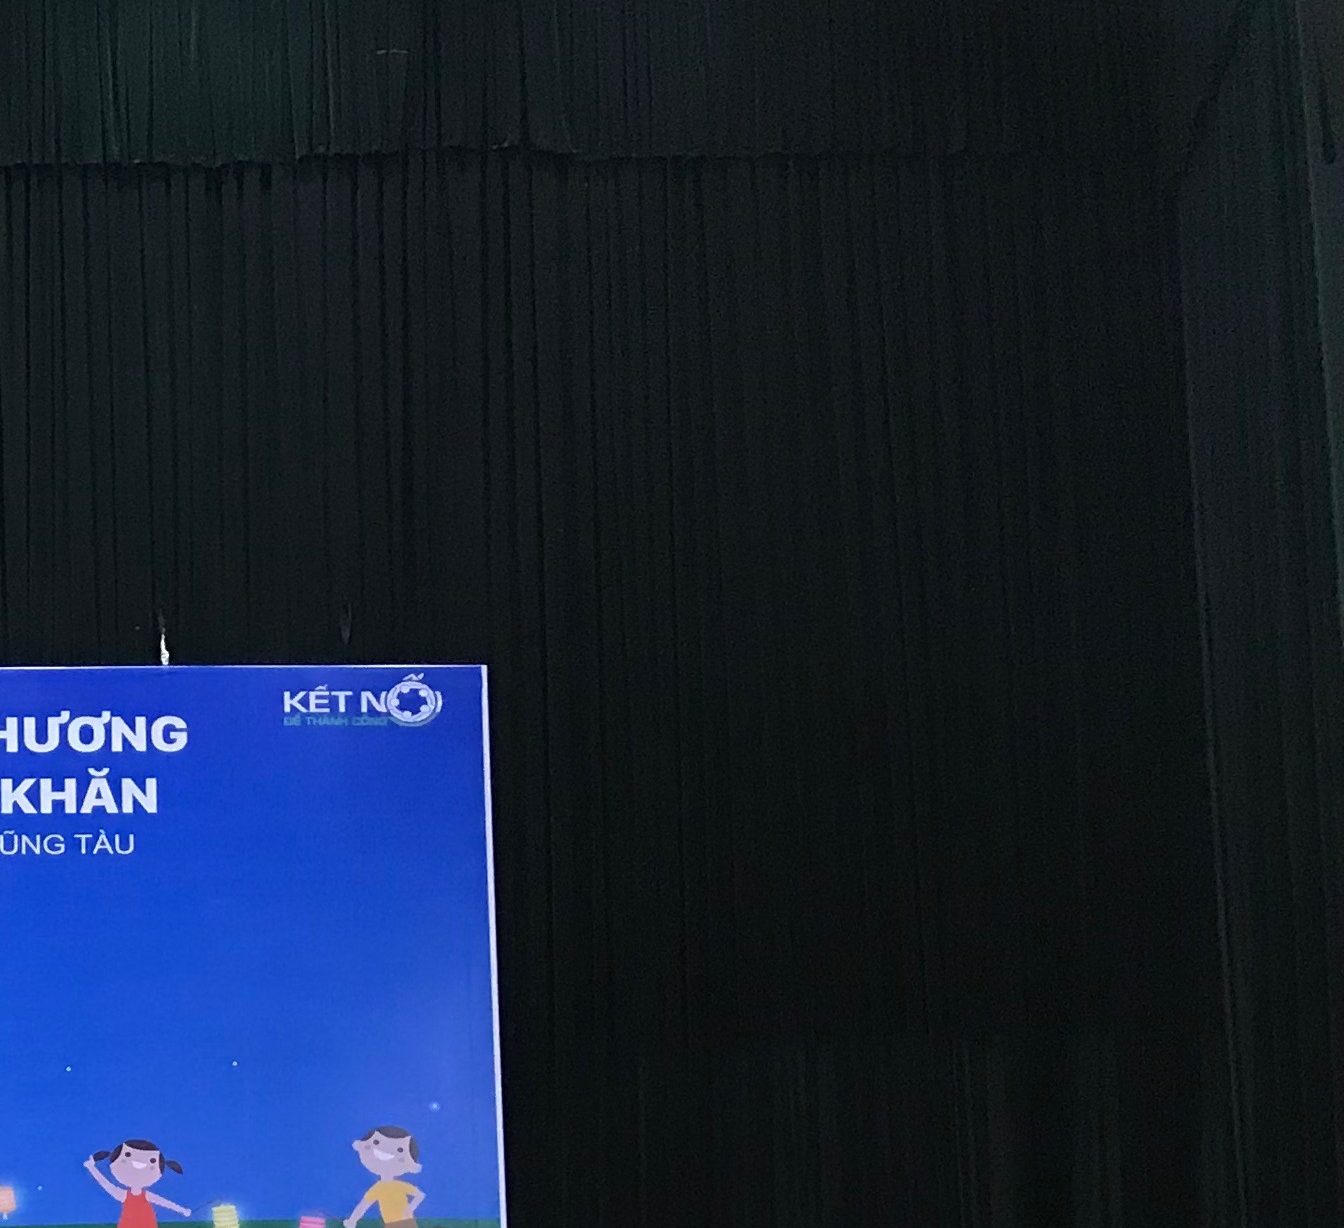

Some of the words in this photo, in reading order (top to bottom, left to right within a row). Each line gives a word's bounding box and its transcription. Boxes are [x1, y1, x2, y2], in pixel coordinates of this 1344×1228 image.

[283, 684, 353, 713] KẾT
[0, 767, 158, 814] KHĂN
[73, 829, 136, 856] TÀU
